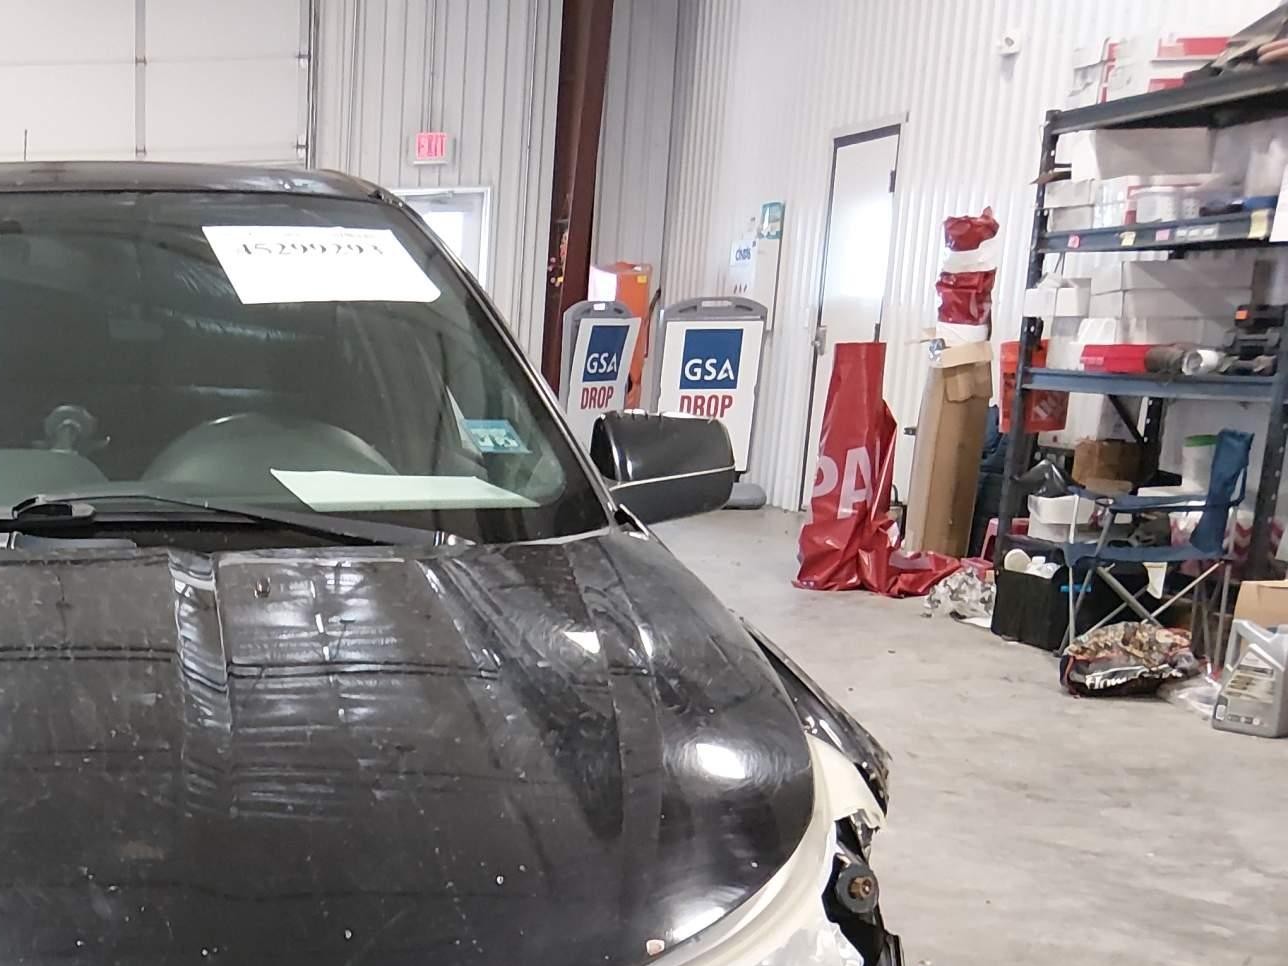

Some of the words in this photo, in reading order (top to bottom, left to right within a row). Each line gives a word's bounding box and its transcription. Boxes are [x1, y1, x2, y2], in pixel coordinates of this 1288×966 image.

[586, 352, 618, 374] GSA
[684, 358, 735, 381] GSA
[580, 386, 614, 410] DROP
[679, 394, 733, 418] DROP
